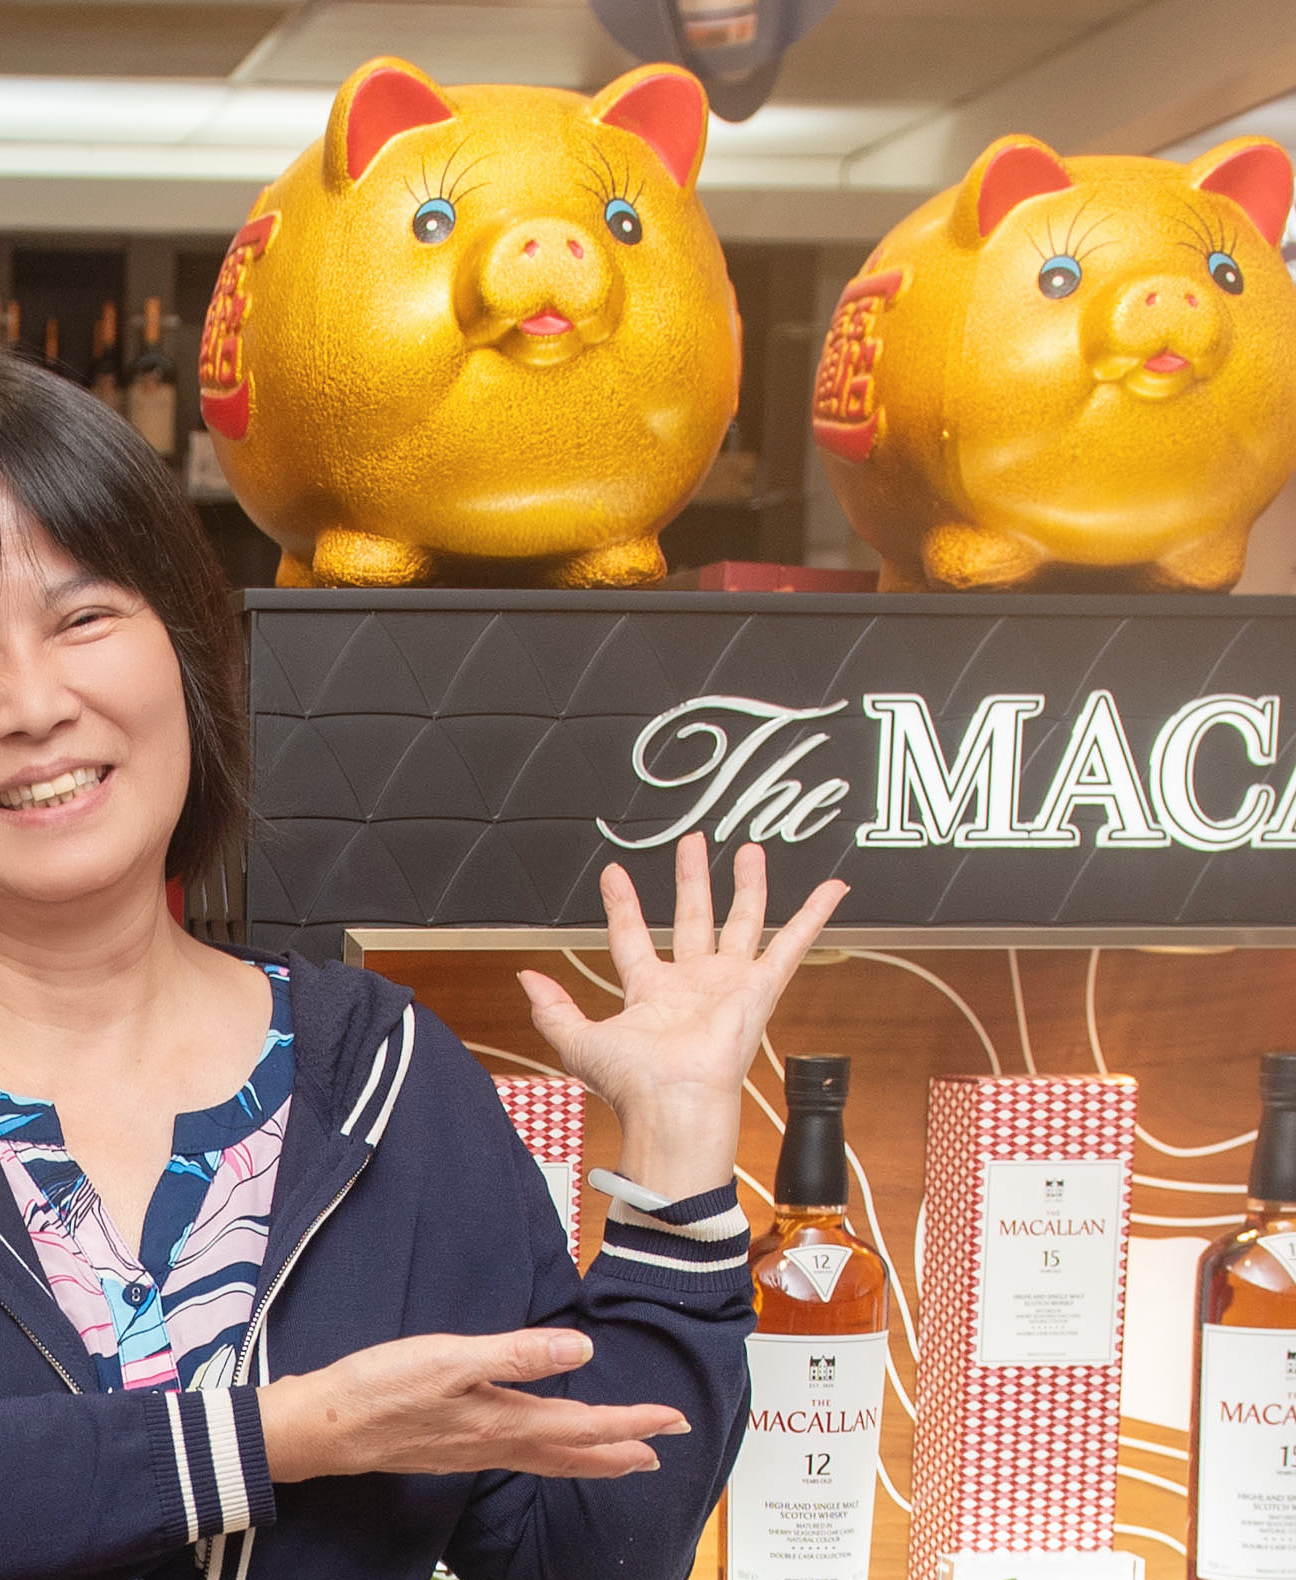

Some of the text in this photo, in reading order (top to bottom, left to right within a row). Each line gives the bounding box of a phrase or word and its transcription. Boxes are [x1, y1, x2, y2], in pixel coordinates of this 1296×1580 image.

[596, 695, 849, 849] The
[999, 1219, 1106, 1236] MACALLAN
[813, 1254, 831, 1269] 12
[1042, 1250, 1061, 1267] 15
[747, 1407, 878, 1434] MACALLAN
[804, 1453, 831, 1476] 12
